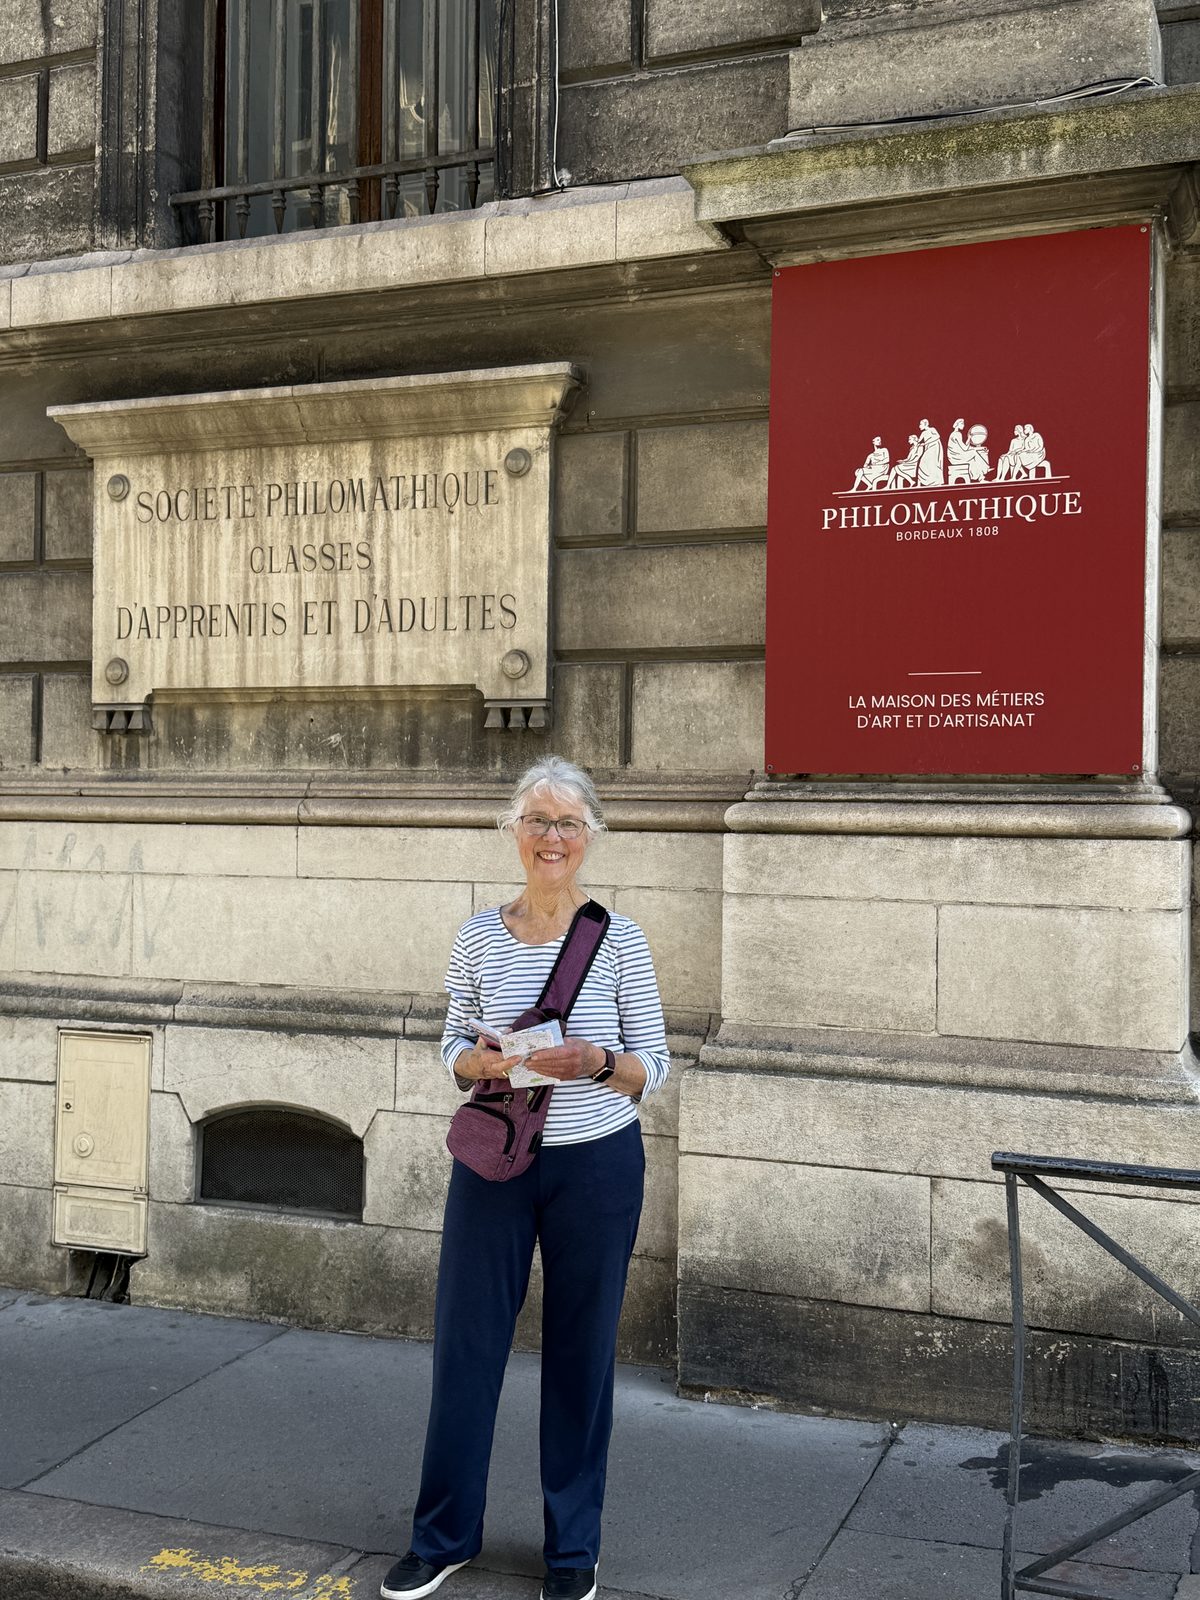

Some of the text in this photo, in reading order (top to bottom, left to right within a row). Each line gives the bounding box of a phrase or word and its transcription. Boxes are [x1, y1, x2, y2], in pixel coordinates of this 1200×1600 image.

[266, 469, 500, 517] PHILOMATHIQUE
[822, 491, 1082, 529] PHILOMATHIQUE
[896, 526, 999, 541] BORDEAUX 1808
[250, 541, 372, 574] CLASSES
[116, 593, 518, 640] D'APPRENTIS ET D'ADULTES
[848, 690, 1045, 708] LA MAISON DES MÉTIERS
[857, 713, 1035, 728] D'ART ET D'ARTISANAT
